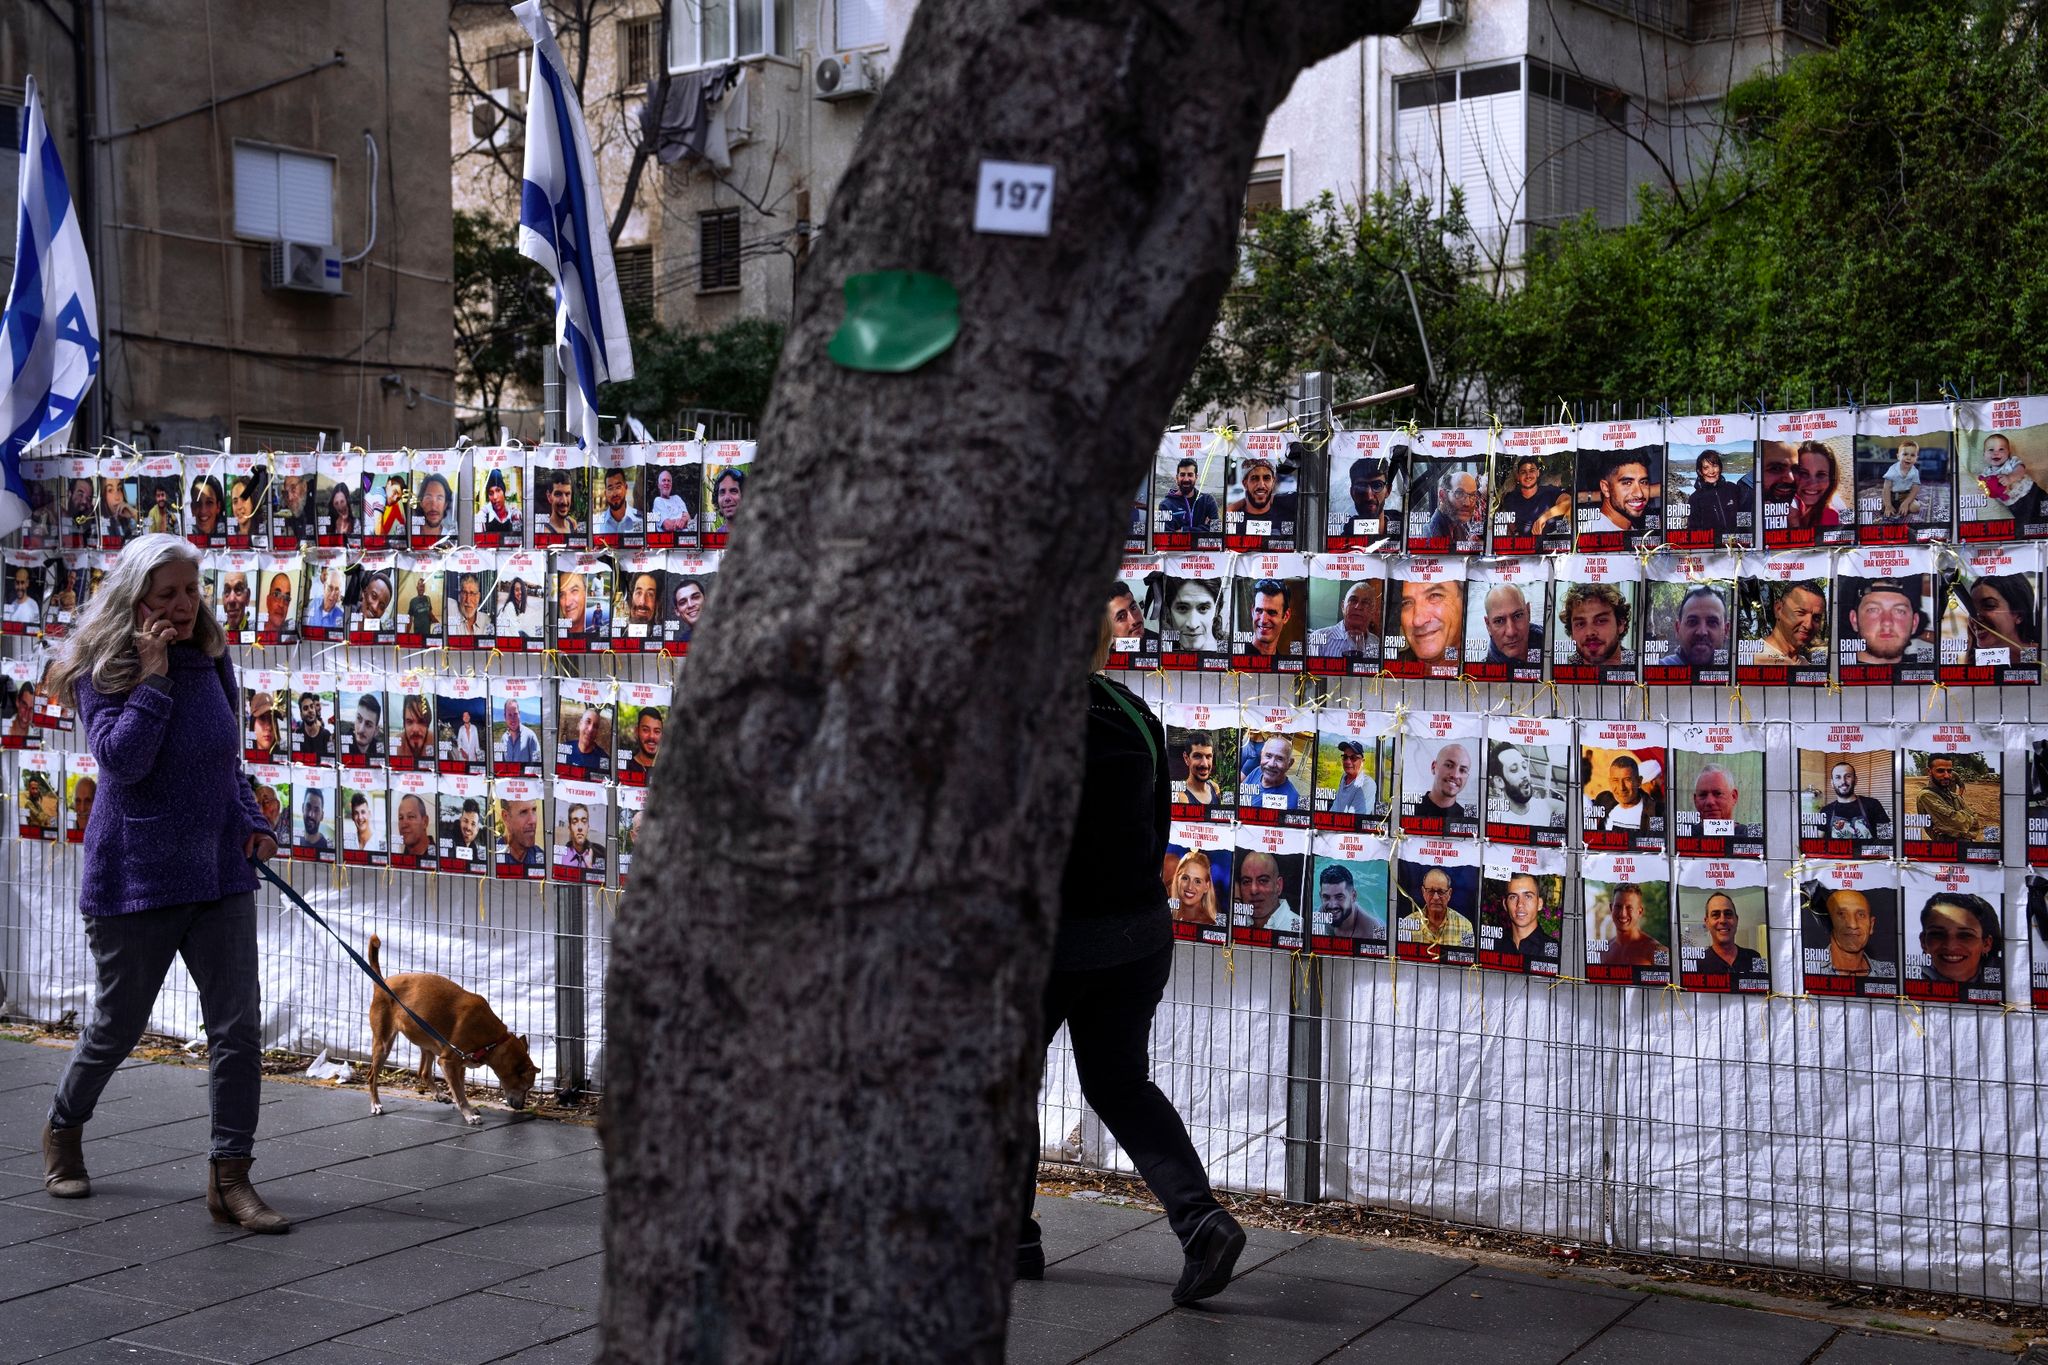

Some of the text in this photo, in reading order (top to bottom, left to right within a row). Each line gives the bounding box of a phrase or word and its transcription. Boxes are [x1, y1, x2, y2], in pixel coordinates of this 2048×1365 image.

[993, 180, 1046, 210] 197
[1858, 498, 1882, 511] BRING
[1960, 494, 1987, 507] BRING
[1578, 508, 1600, 520] BRING
[1667, 503, 1690, 516] BRING
[1765, 503, 1790, 515] BRING
[1960, 509, 1977, 521] HIM
[1495, 512, 1515, 524] BRING
[1667, 517, 1682, 529] HER
[1765, 516, 1788, 529] THEM
[1578, 522, 1592, 533] HIM
[1554, 640, 1576, 652] BRING
[1645, 641, 1669, 652] BRING
[1738, 640, 1764, 653] BRING
[1840, 639, 1866, 652] BRING
[1941, 639, 1968, 652] BRING
[1645, 654, 1659, 665] HIM
[1840, 653, 1856, 665] HIM
[1941, 653, 1958, 665] HER
[1947, 742, 1957, 751] (19)
[1240, 784, 1259, 795] BRING
[1315, 788, 1336, 799] BRING
[1315, 800, 1327, 811] HIM
[1488, 799, 1510, 811] BRING
[1584, 806, 1605, 818] BRING
[1676, 811, 1700, 824] BRING
[1802, 812, 1826, 824] BRING
[1584, 819, 1597, 830] HIM
[1904, 814, 1931, 827] BRING
[1676, 825, 1692, 836] HIM
[1802, 826, 1818, 838] HIM
[1904, 828, 1921, 840] HIM
[2029, 832, 2047, 845] HIM
[1482, 925, 1503, 938] BRING
[1481, 938, 1494, 950] HIM
[1586, 940, 1609, 952] BRING
[1587, 952, 1602, 964] HIM
[1682, 947, 1705, 959] BRING
[1805, 948, 1830, 961] BRING
[1906, 953, 1932, 966] BRING
[1682, 960, 1698, 972] HIM
[1805, 962, 1822, 974] HIM
[1906, 967, 1922, 979] HER
